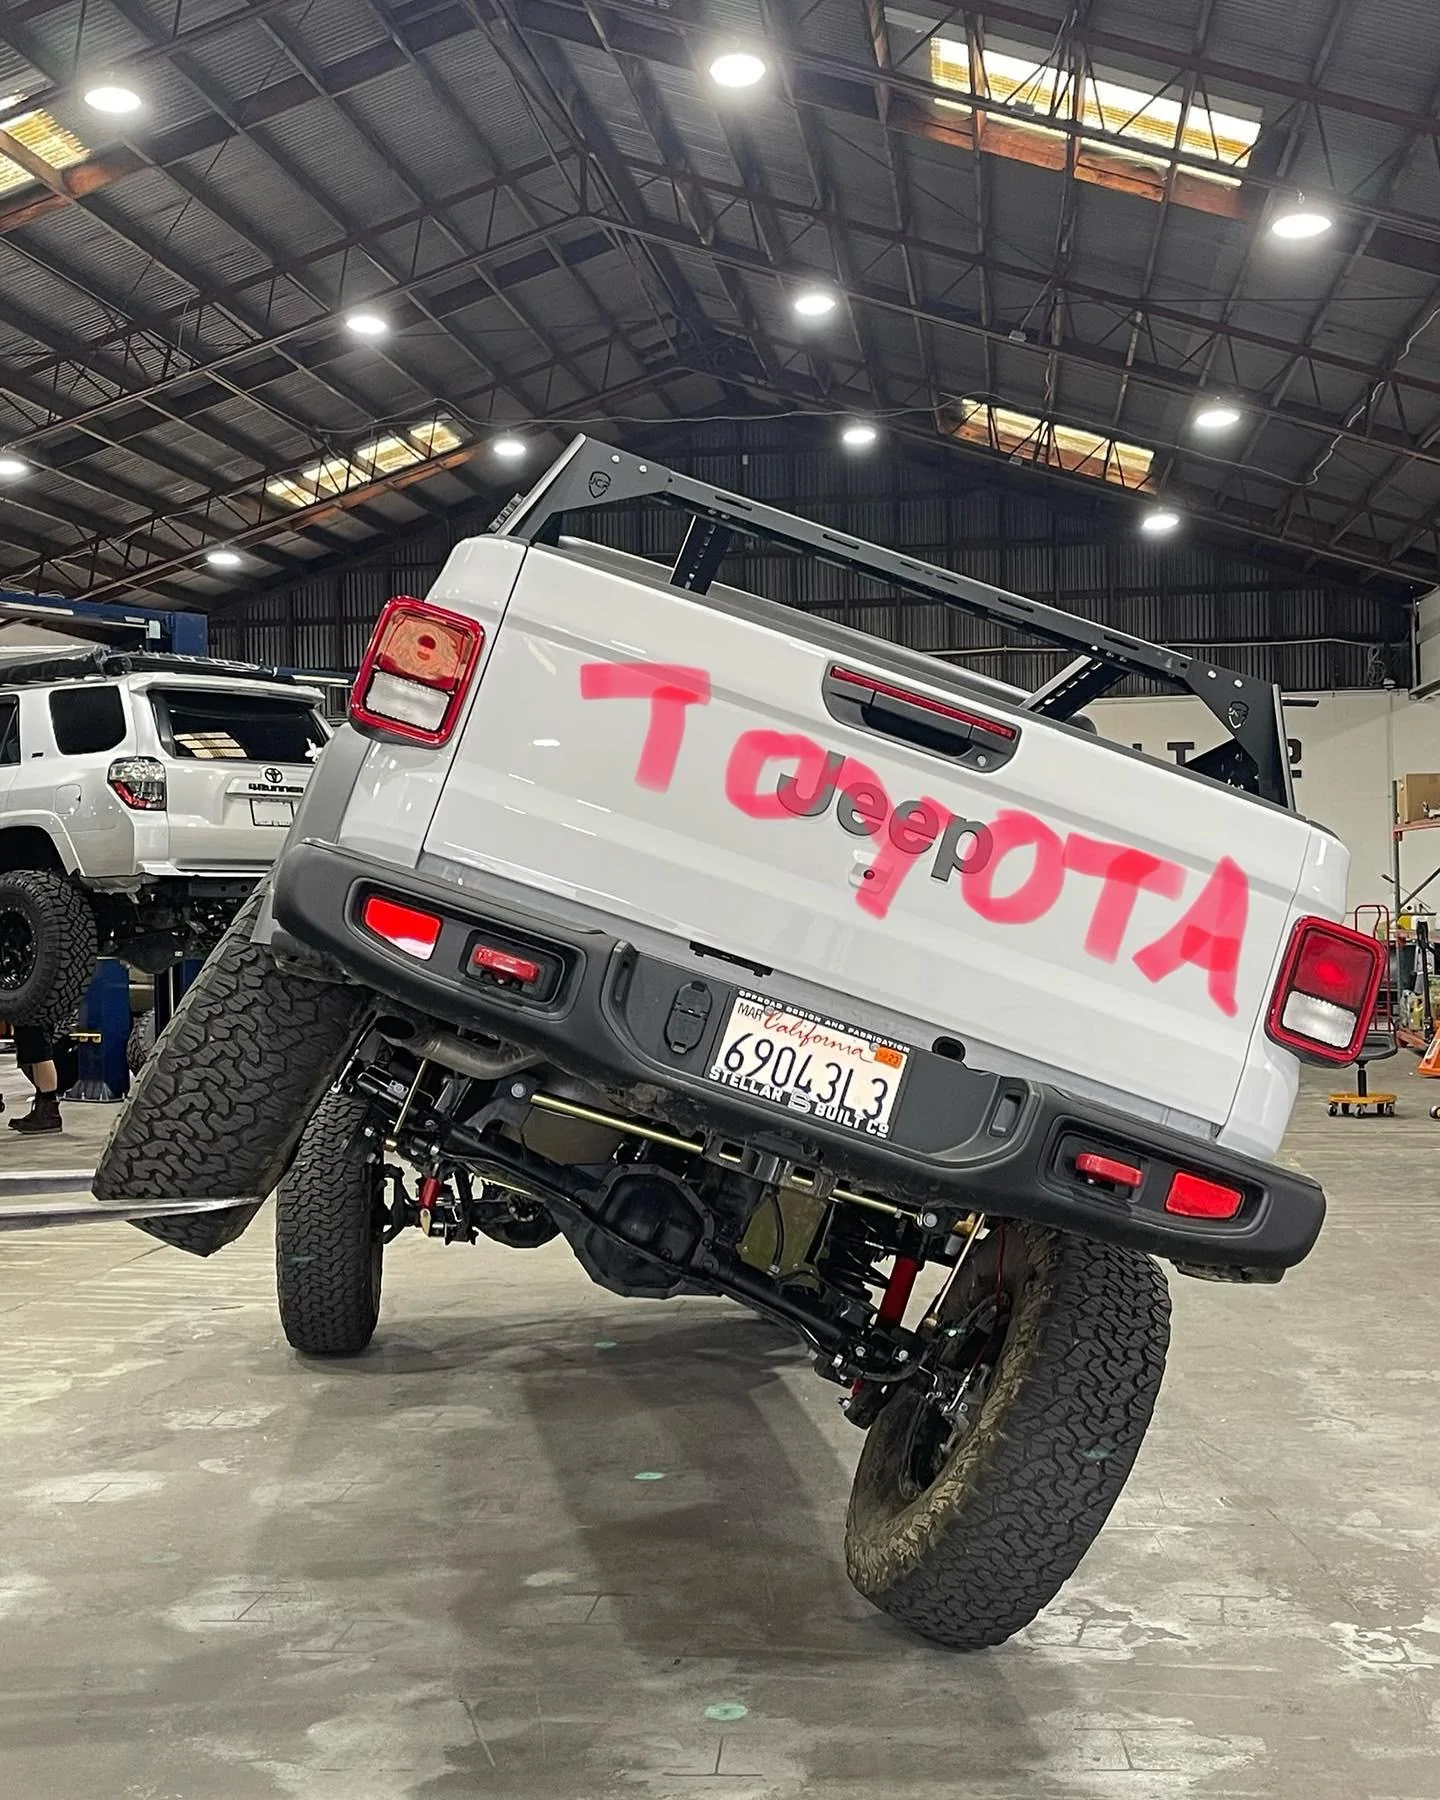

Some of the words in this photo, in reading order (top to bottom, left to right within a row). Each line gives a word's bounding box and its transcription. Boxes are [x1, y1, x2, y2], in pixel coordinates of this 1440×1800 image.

[777, 750, 993, 882] Jeep
[737, 1002, 763, 1022] MAR
[738, 990, 783, 1010] OFFROAD
[785, 1006, 822, 1023] DESIGN
[824, 1020, 846, 1031] AND
[847, 1027, 911, 1054] FABRICATION
[764, 1009, 873, 1064] California
[887, 1052, 900, 1065] 23
[709, 1065, 783, 1102] STELLAR
[814, 1102, 866, 1130] BUILT
